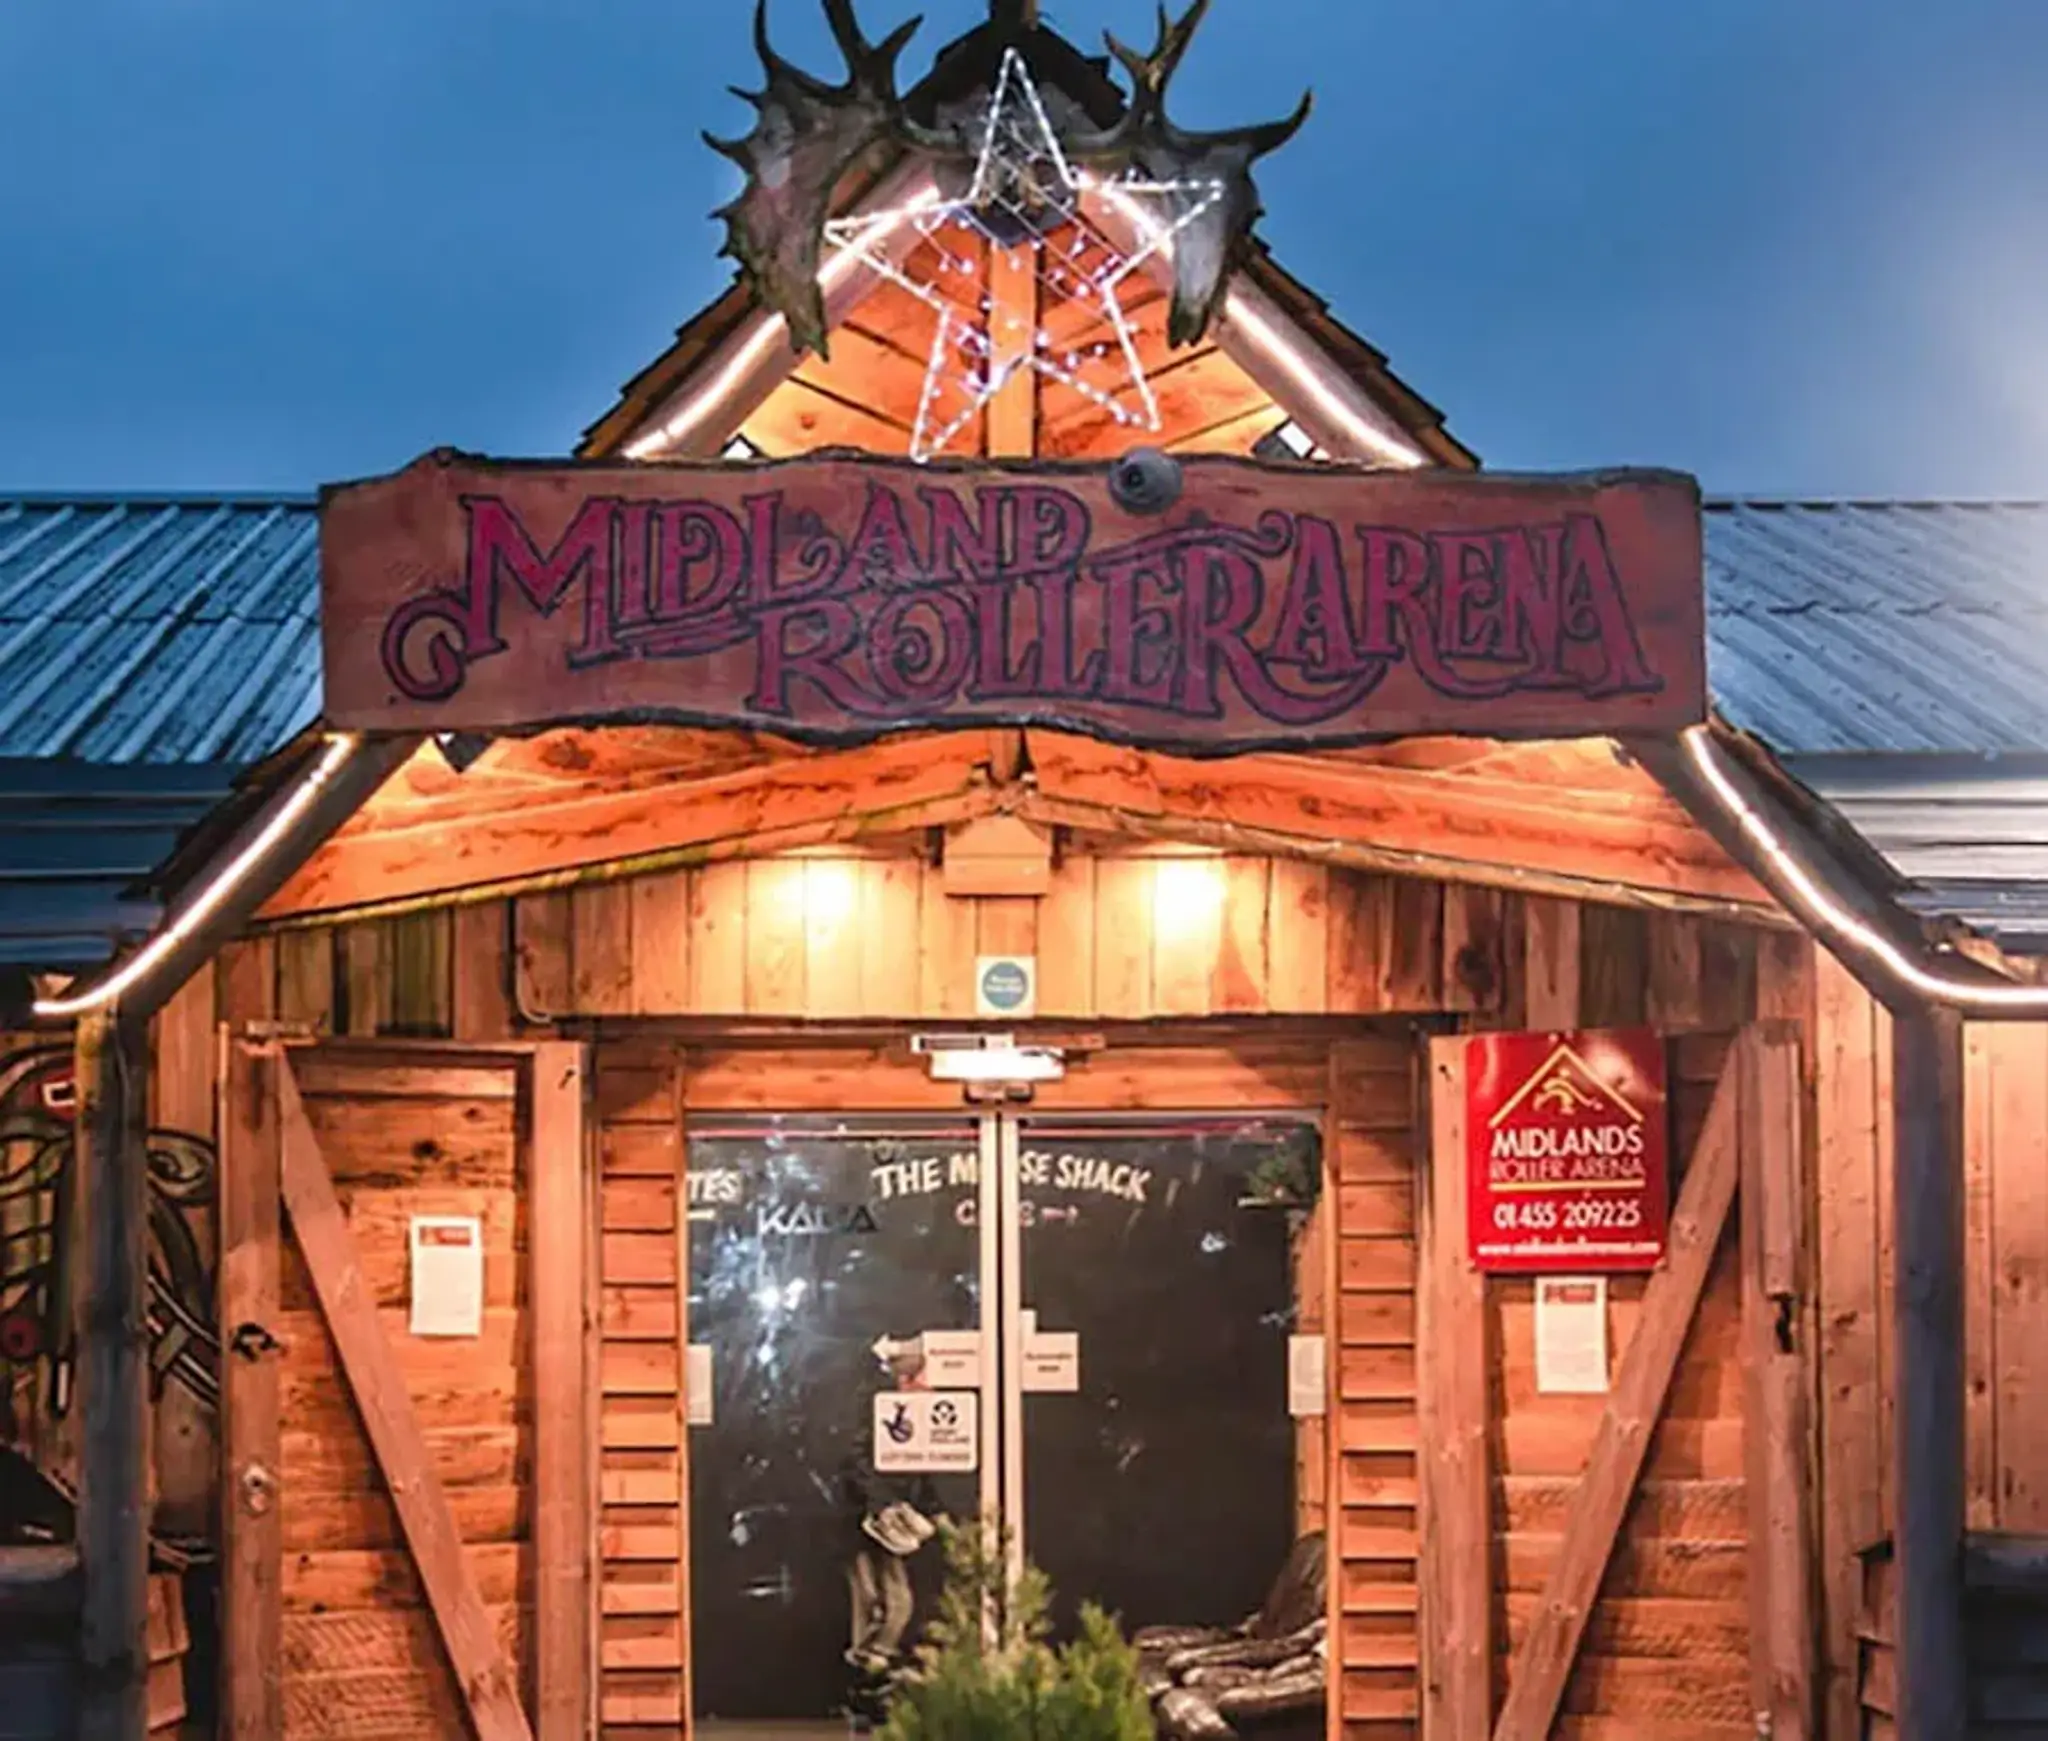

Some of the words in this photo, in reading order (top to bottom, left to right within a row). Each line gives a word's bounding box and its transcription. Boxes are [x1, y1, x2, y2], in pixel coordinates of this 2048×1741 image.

[382, 479, 1091, 699] MIDLAND
[746, 510, 1388, 724] ROLLER
[1262, 511, 1664, 699] ARENA
[872, 1157, 943, 1199] THE
[949, 1151, 1051, 1185] MSE
[1054, 1154, 1150, 1201] SHACK
[1491, 1125, 1645, 1158] MIDLANDS
